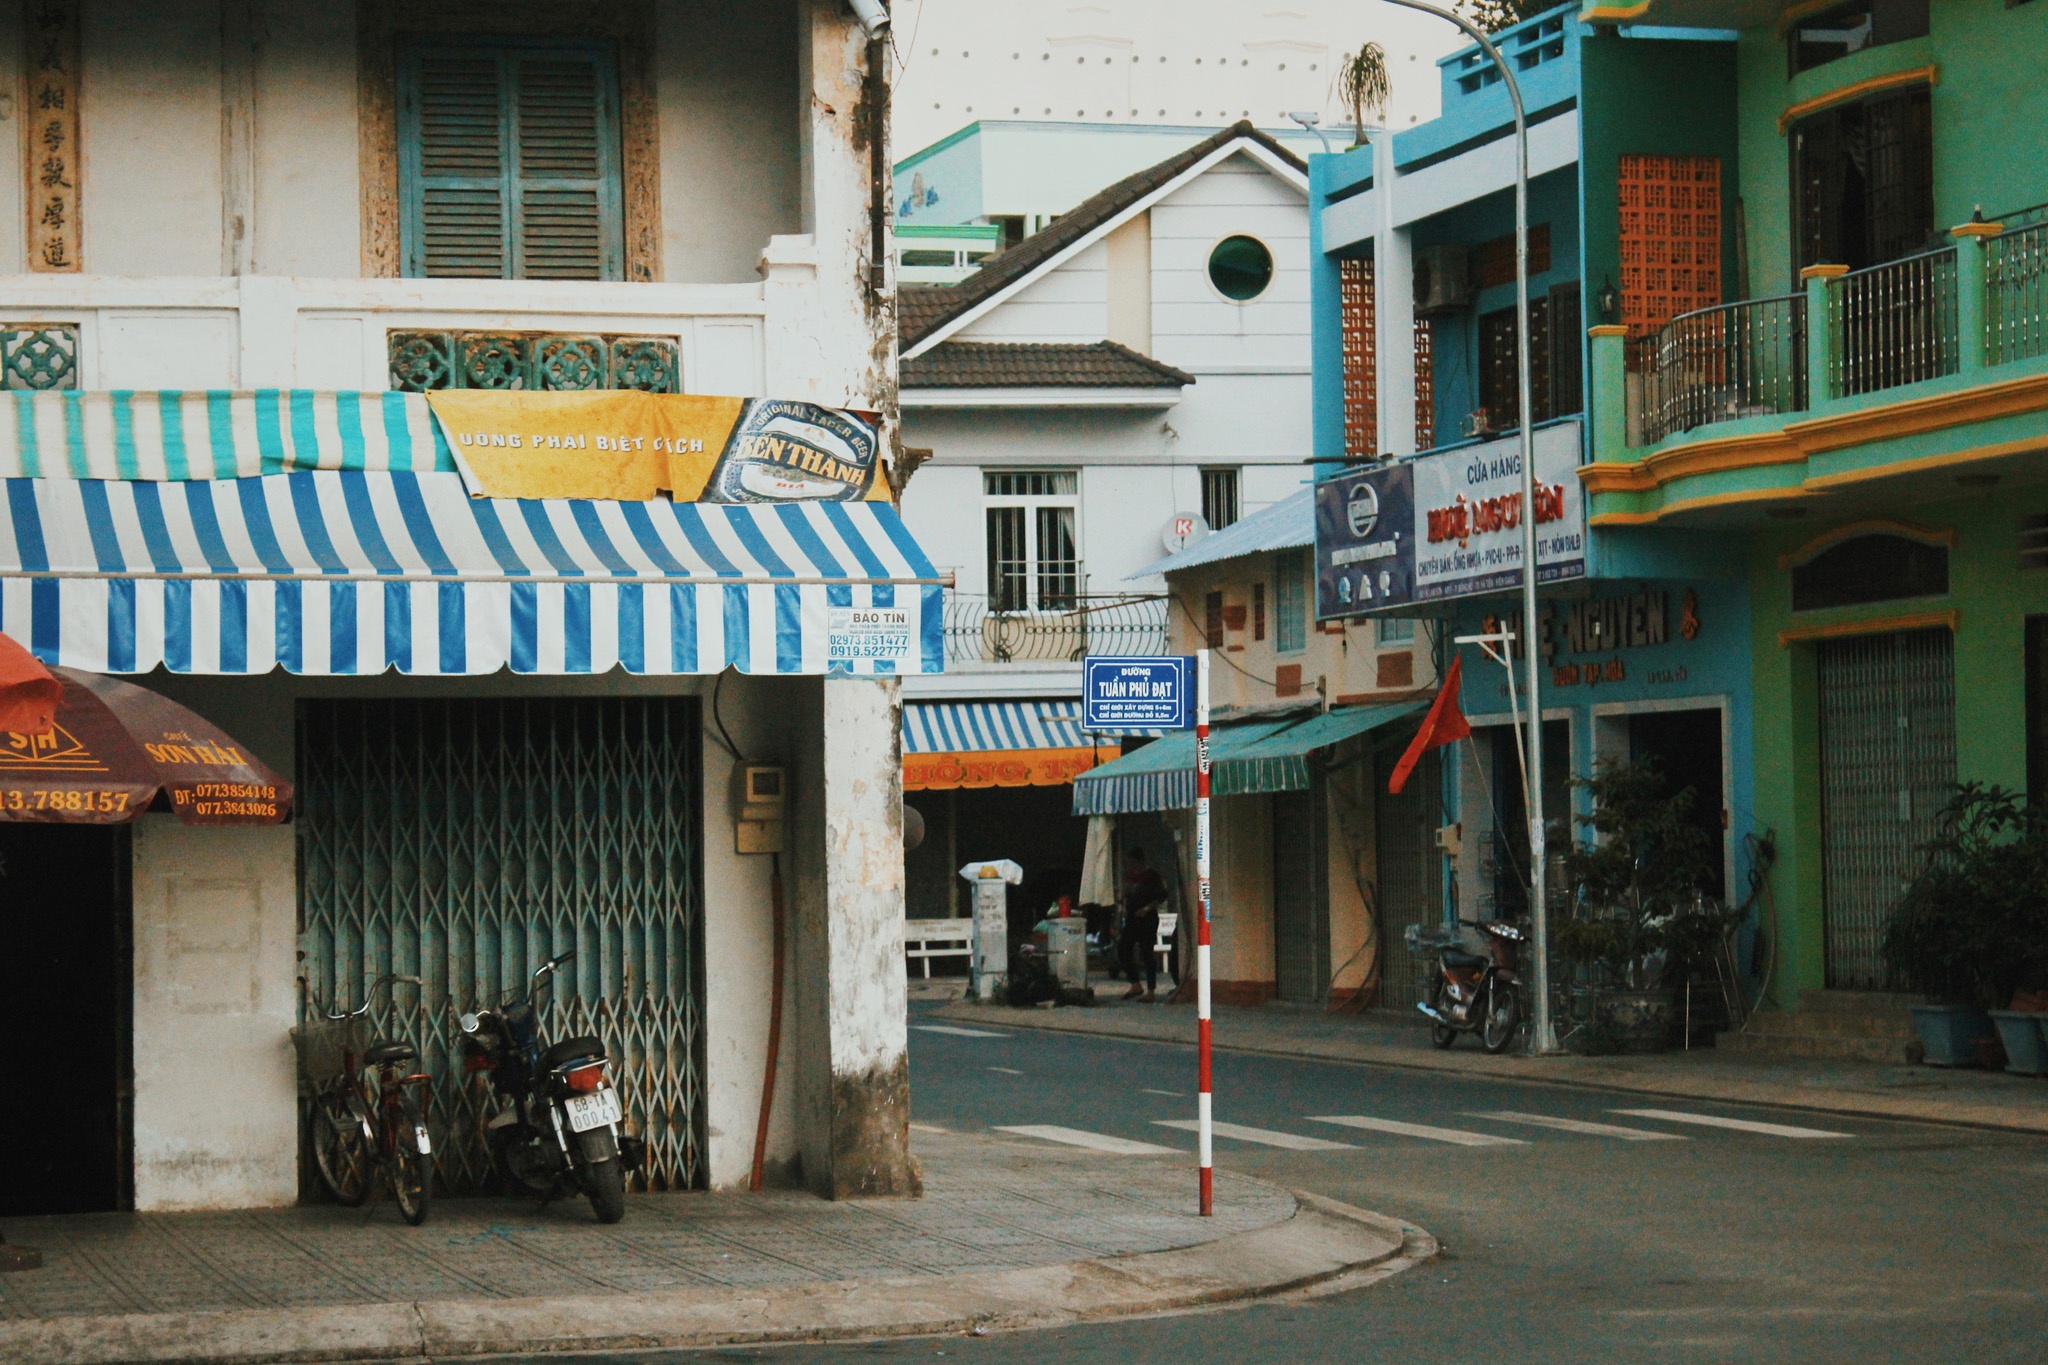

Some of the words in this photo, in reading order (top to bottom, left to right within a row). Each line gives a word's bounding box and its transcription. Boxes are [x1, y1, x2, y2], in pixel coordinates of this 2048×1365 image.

[756, 404, 806, 426] ORIGINAL
[851, 433, 868, 459] BEER
[787, 442, 867, 487] THÀNH
[1467, 456, 1488, 485] CỬA
[1491, 453, 1521, 478] HÀNG
[830, 635, 908, 645] 02973.851477
[831, 646, 908, 656] 0919.522777
[1121, 666, 1151, 676] ĐƯỜNG
[1099, 676, 1126, 697] TUẦN
[1129, 676, 1149, 697] PHỦ
[1152, 681, 1173, 700] ĐẠT
[196, 803, 277, 816] 077.3843026
